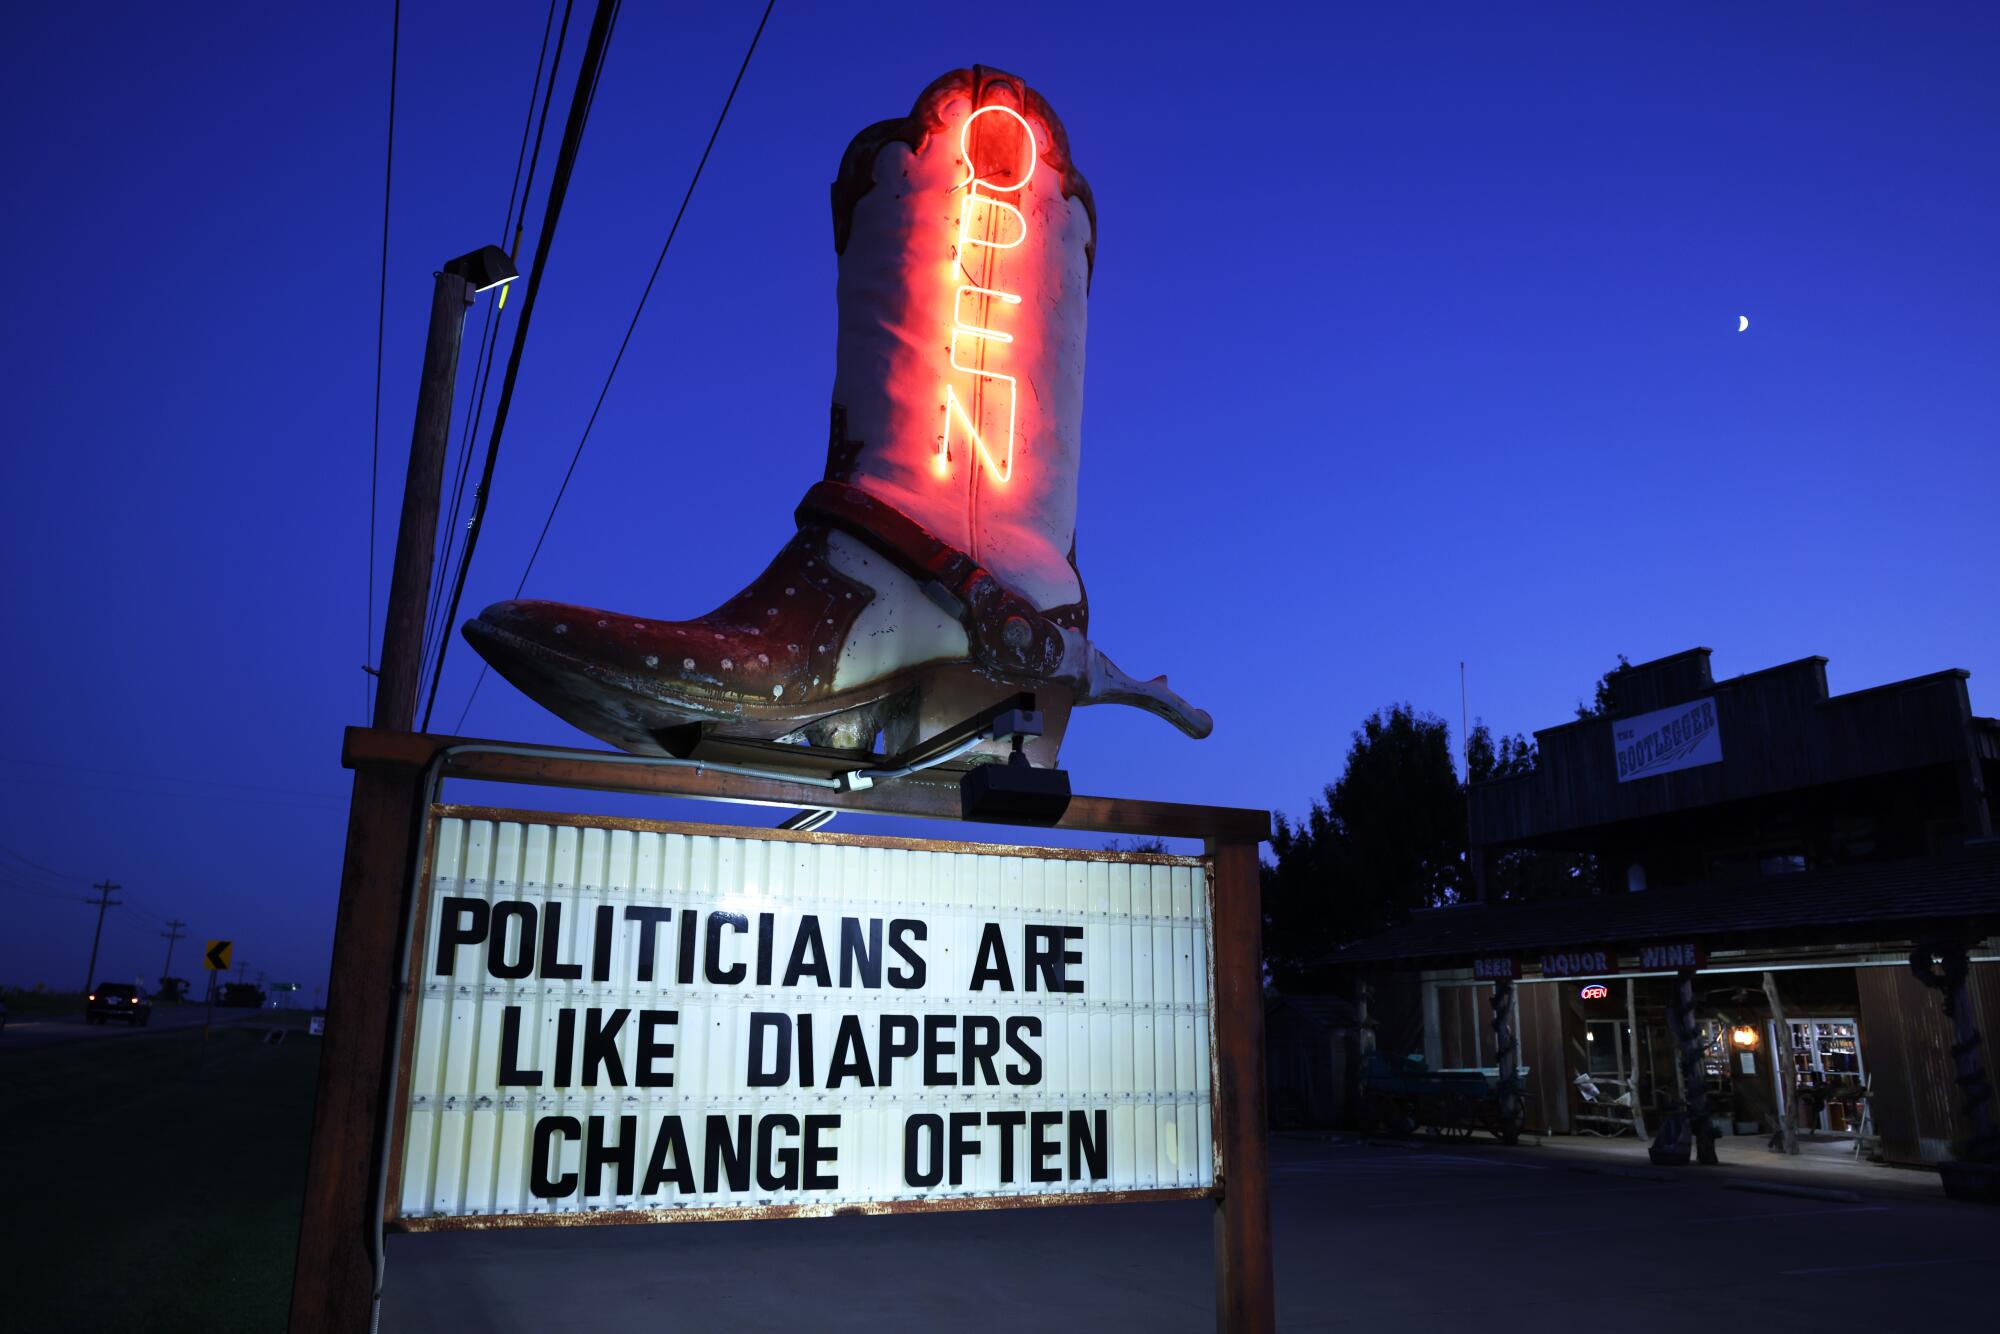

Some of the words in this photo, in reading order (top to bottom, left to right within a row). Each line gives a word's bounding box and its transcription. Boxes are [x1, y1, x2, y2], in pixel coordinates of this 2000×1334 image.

[939, 105, 1036, 482] OPEN
[1617, 729, 1634, 741] THE
[1617, 702, 1715, 778] BOOTLEGGER
[436, 896, 928, 989] POLITICIANS
[969, 922, 1085, 993] ARE
[1474, 958, 1512, 977] BEER
[1542, 952, 1607, 975] LIQUOR
[1641, 944, 1696, 968] WINE
[1583, 988, 1608, 999] OPEN
[499, 1005, 679, 1087] LIKE
[747, 1011, 1042, 1088] DIAPERS
[530, 1113, 841, 1198] CHANGE
[904, 1109, 1108, 1187] OFTEN
